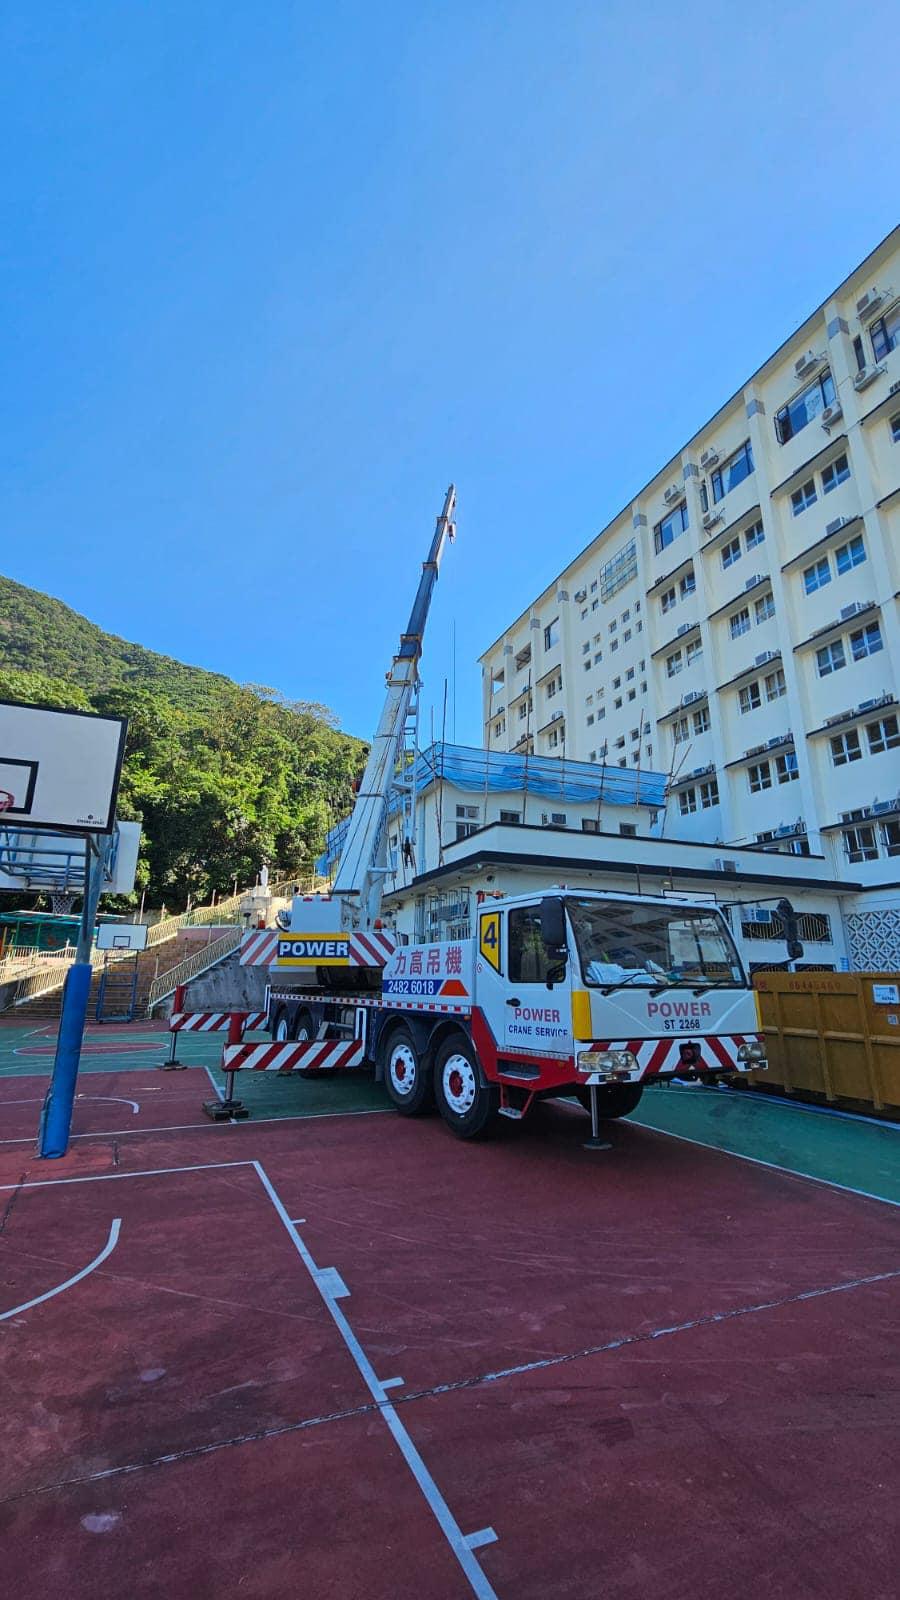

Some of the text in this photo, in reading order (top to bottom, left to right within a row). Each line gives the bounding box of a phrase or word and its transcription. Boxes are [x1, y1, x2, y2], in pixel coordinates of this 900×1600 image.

[483, 921, 498, 949] 4
[279, 941, 349, 956] POWER
[394, 946, 463, 976] 力高吊機
[388, 980, 434, 994] 2482 6018
[514, 1007, 560, 1023] POWER
[647, 1002, 711, 1017] POWER
[508, 1024, 568, 1038] CRANE SERVICE
[664, 1018, 701, 1030] ST 2268
